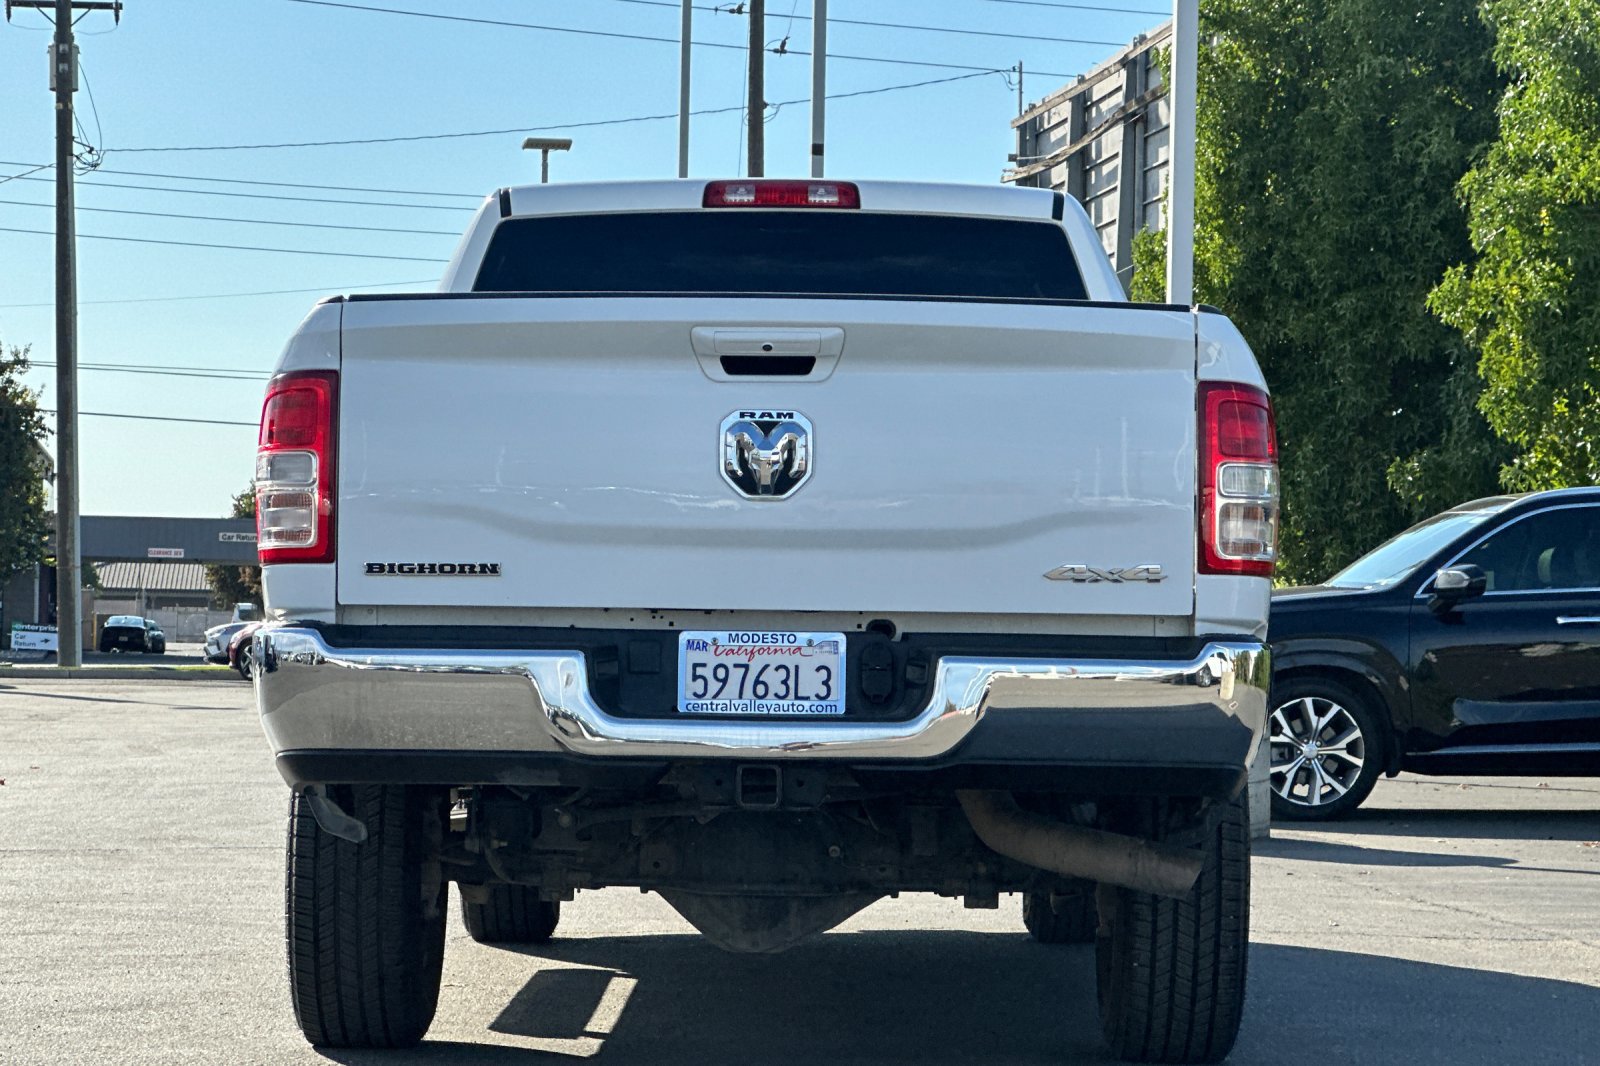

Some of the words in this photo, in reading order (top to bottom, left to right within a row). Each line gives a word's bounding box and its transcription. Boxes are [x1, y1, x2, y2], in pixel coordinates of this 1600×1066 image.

[739, 411, 794, 419] RAM
[364, 562, 501, 576] BIGHORN
[1042, 564, 1168, 583] 4x4
[686, 639, 708, 652] MAR
[728, 633, 797, 644] MODESTO
[713, 645, 813, 662] California
[691, 662, 832, 701] 59763L3
[686, 700, 838, 714] centralvalleyauto.com
